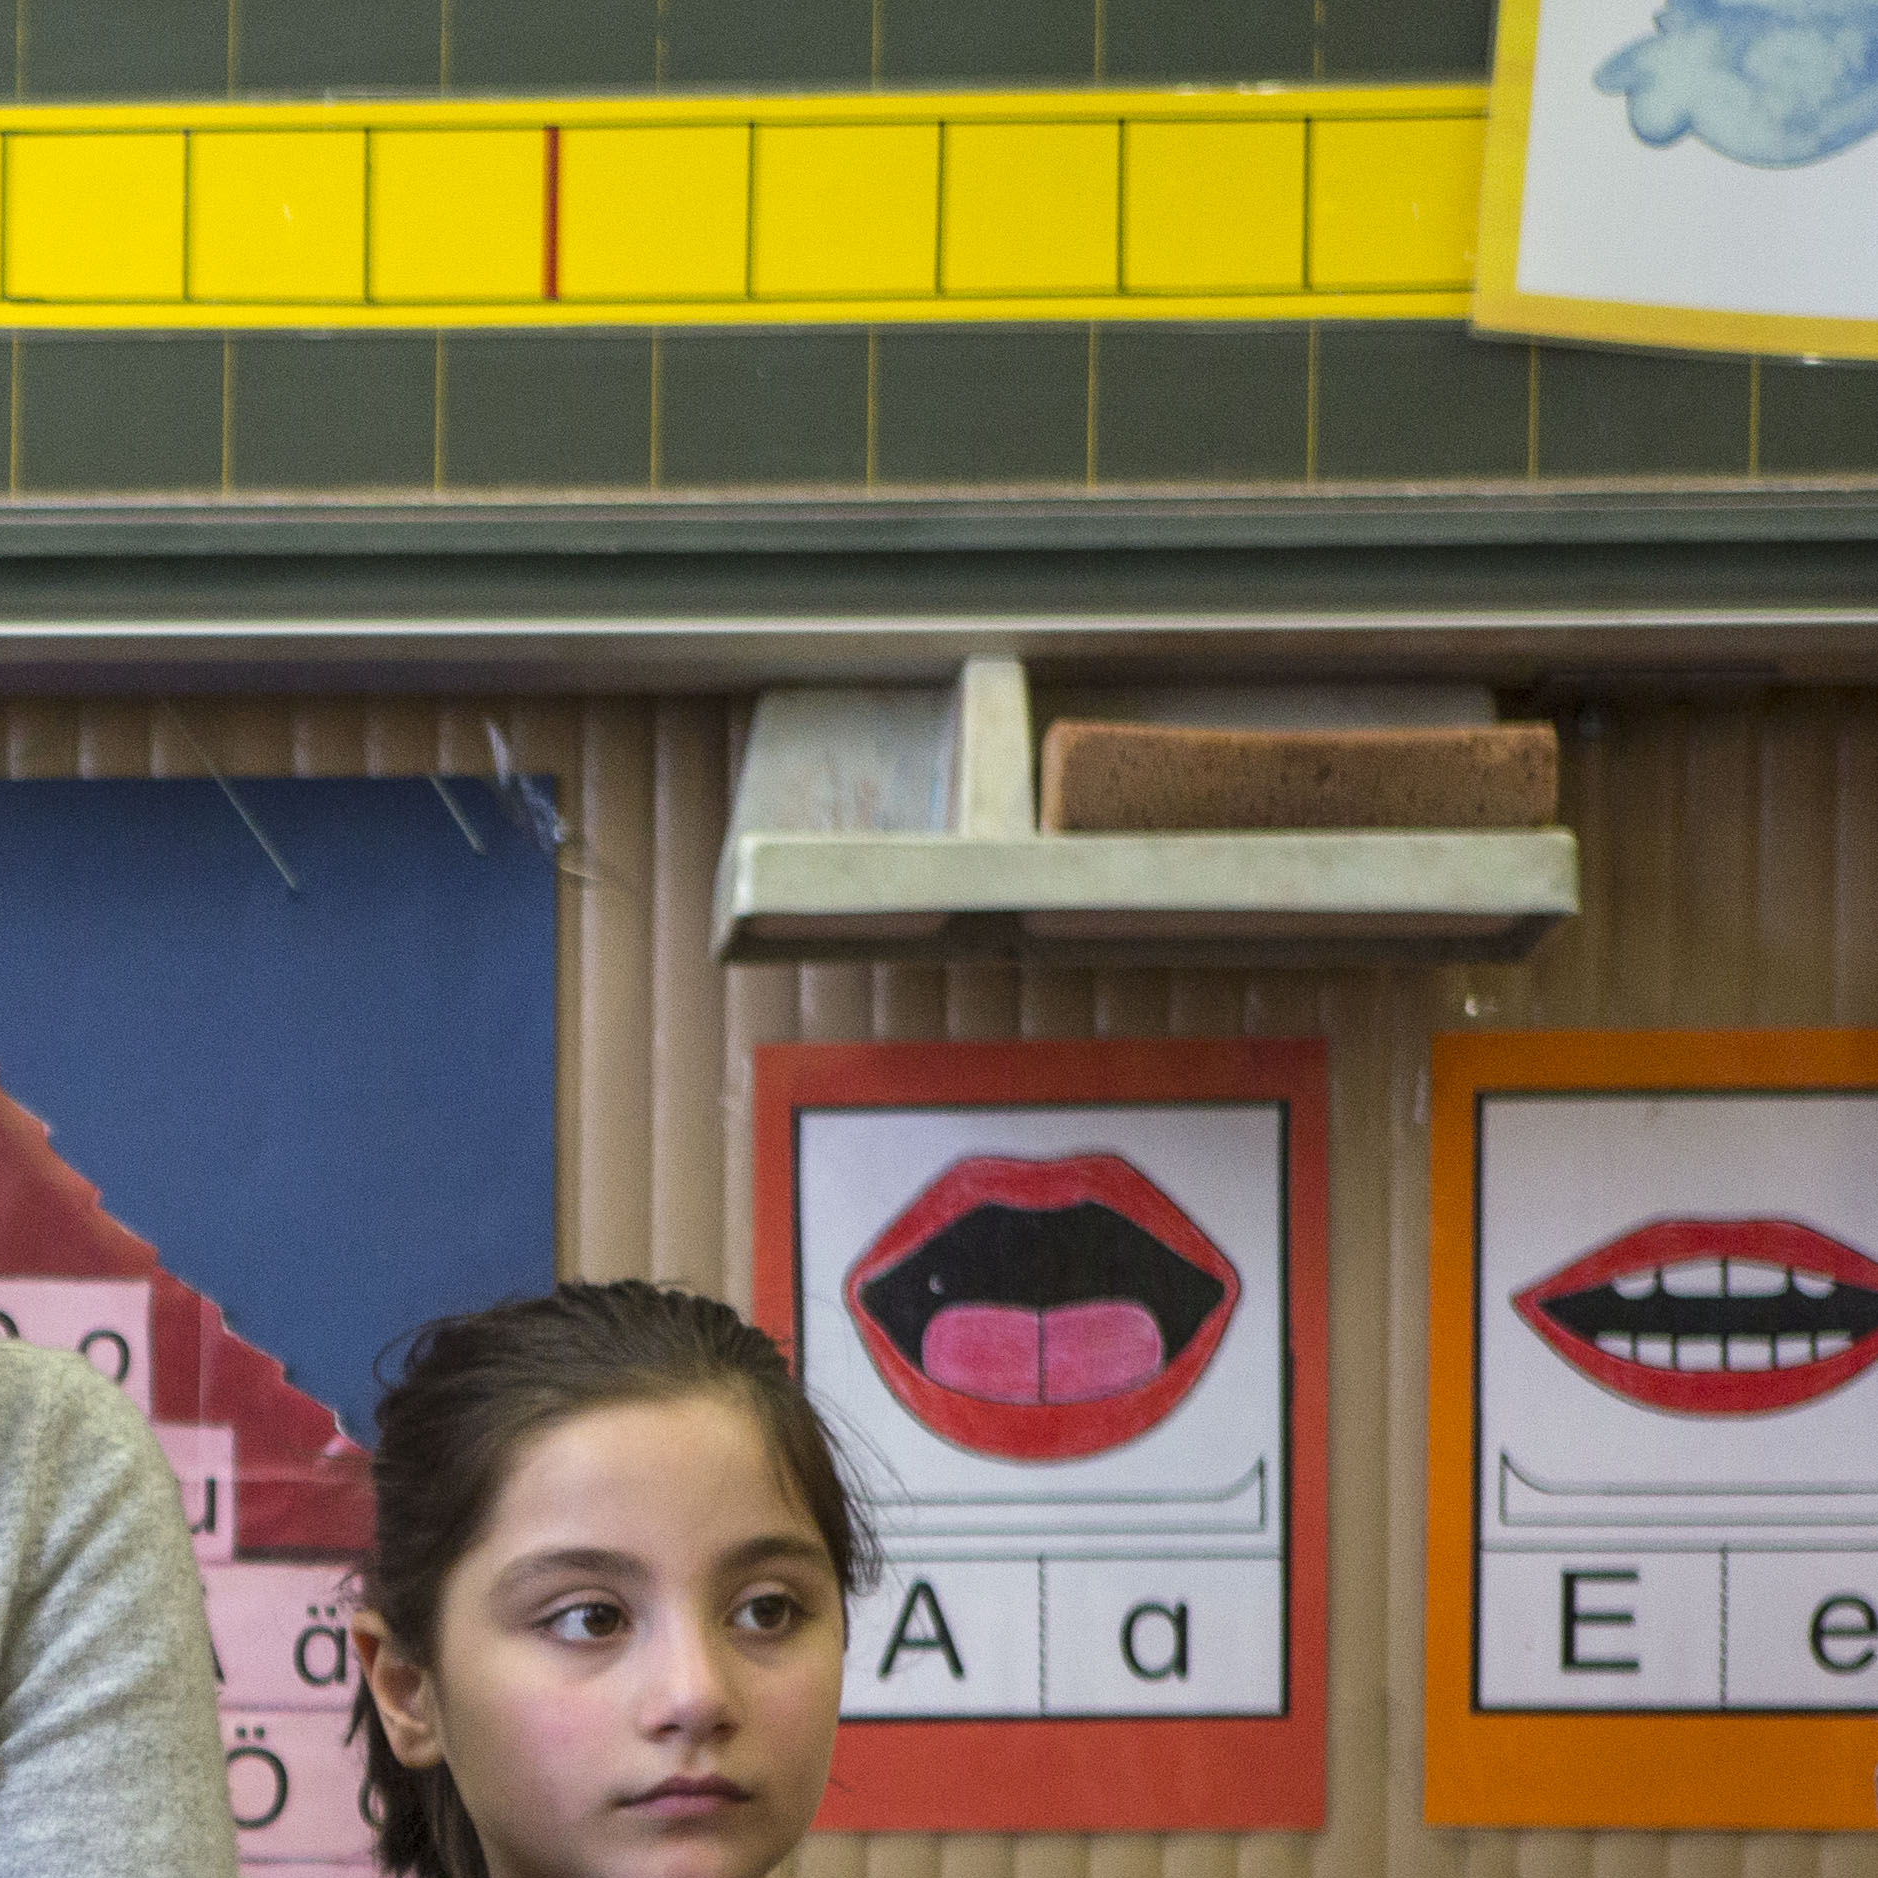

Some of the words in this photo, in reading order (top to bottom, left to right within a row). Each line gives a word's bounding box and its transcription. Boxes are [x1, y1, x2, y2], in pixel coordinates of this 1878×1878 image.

[293, 1606, 348, 1687] ä
[879, 1578, 965, 1680] A
[1120, 1601, 1190, 1680] a
[1560, 1568, 1642, 1673] E
[1809, 1592, 1878, 1675] e
[225, 1725, 289, 1831] Ö
